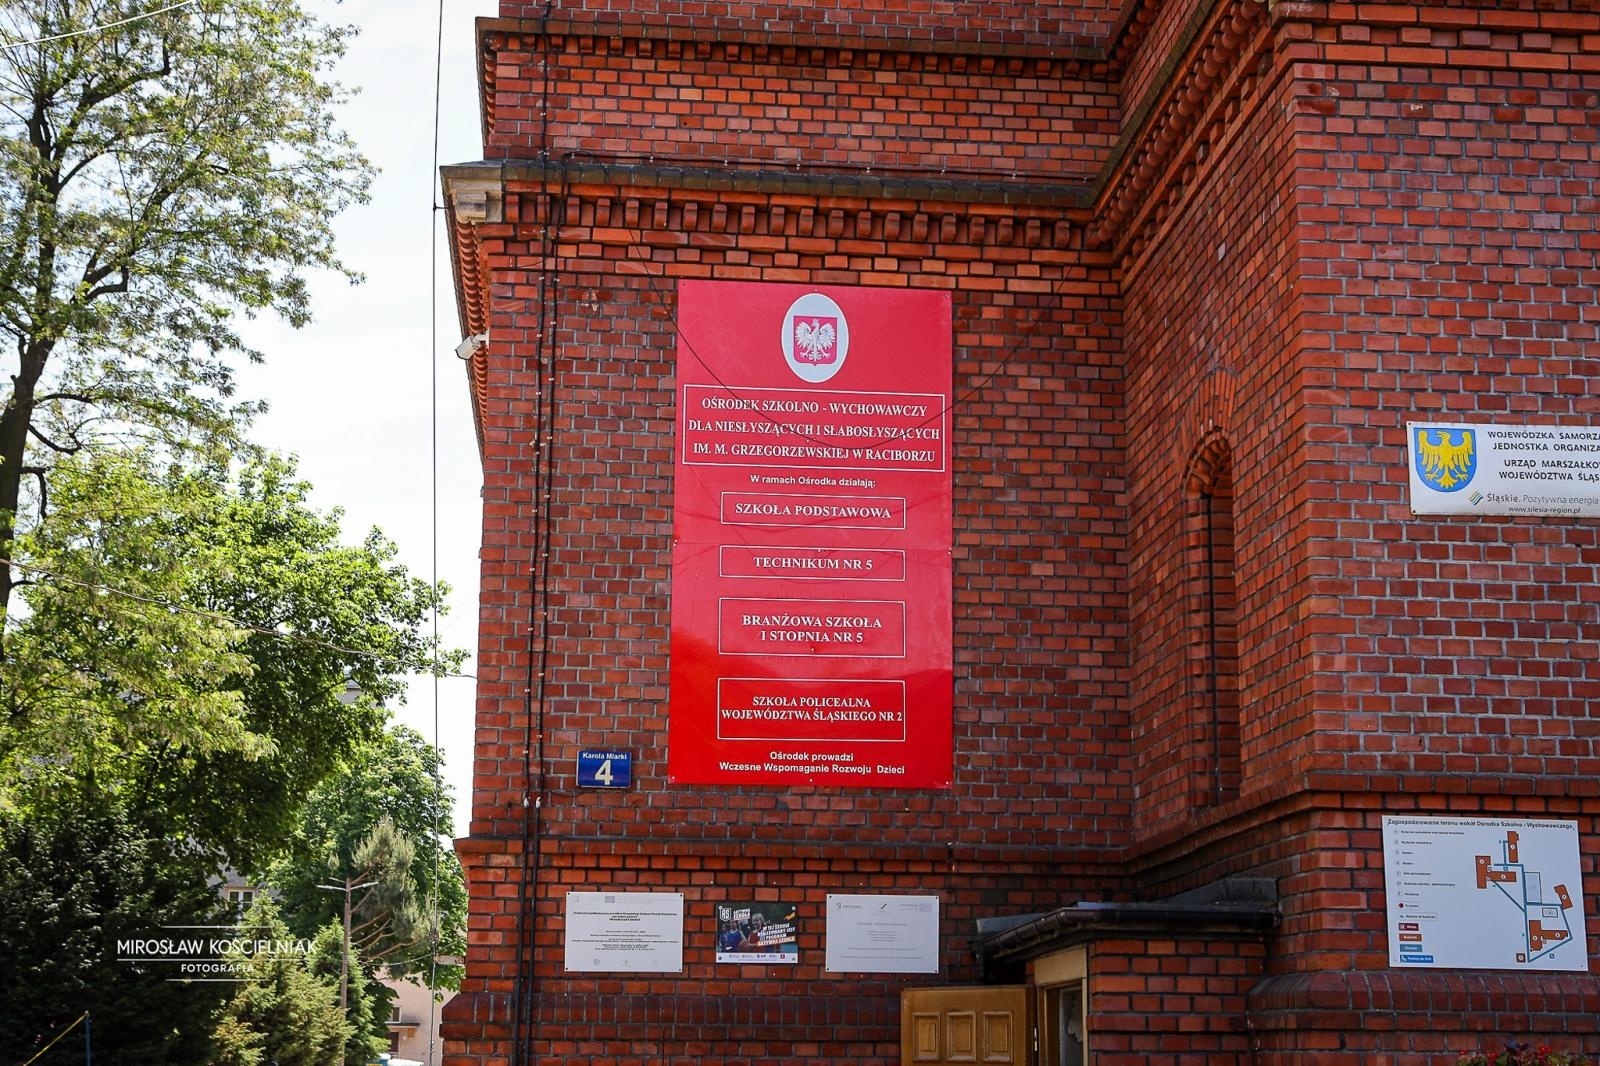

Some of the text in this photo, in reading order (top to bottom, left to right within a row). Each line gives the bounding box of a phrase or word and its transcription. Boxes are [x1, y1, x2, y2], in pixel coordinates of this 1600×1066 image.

[702, 396, 760, 412] OŚRODEK
[762, 400, 819, 412] SZKOLNO
[830, 402, 928, 417] WYCHOWAWCZY
[688, 420, 940, 442] DLA NIESŁYSZĄCYCH I SŁABOSŁYSZĄCYCH
[1488, 429, 1600, 440] WOJEWÓDZKA SAMORZ
[694, 442, 935, 462] IM. M. GRZEGORZEWSKIEJ W RACIBORZU
[1493, 442, 1548, 451] JEDNOSTKA
[1504, 459, 1600, 470] URZĄD MARSZAŁKO
[750, 474, 876, 488] W ramach Ośrodka działają:
[1499, 470, 1573, 481] WOJEWÓDZTWA
[1486, 493, 1598, 506] Śląskie. Pozytywna energia
[736, 503, 891, 518] SZKOŁA PODSTAWOWA
[1508, 506, 1581, 514] www.silesia-region.pl
[754, 557, 873, 570] TECHNIKUM NR 5
[742, 613, 882, 628] BRANŻOWA SZKOŁA
[761, 630, 863, 643] I STOPNIA NR 5
[752, 696, 871, 708] SZKOŁA POLICEALNA
[721, 707, 902, 722] WOJEWÓDZTWA ŚLĄSKIEGO NR 2
[770, 752, 854, 762] Ośrodek prowadzi
[594, 760, 614, 785] 4
[720, 762, 904, 774] Wczesne Wspomaganie Rozwoju Dzieci
